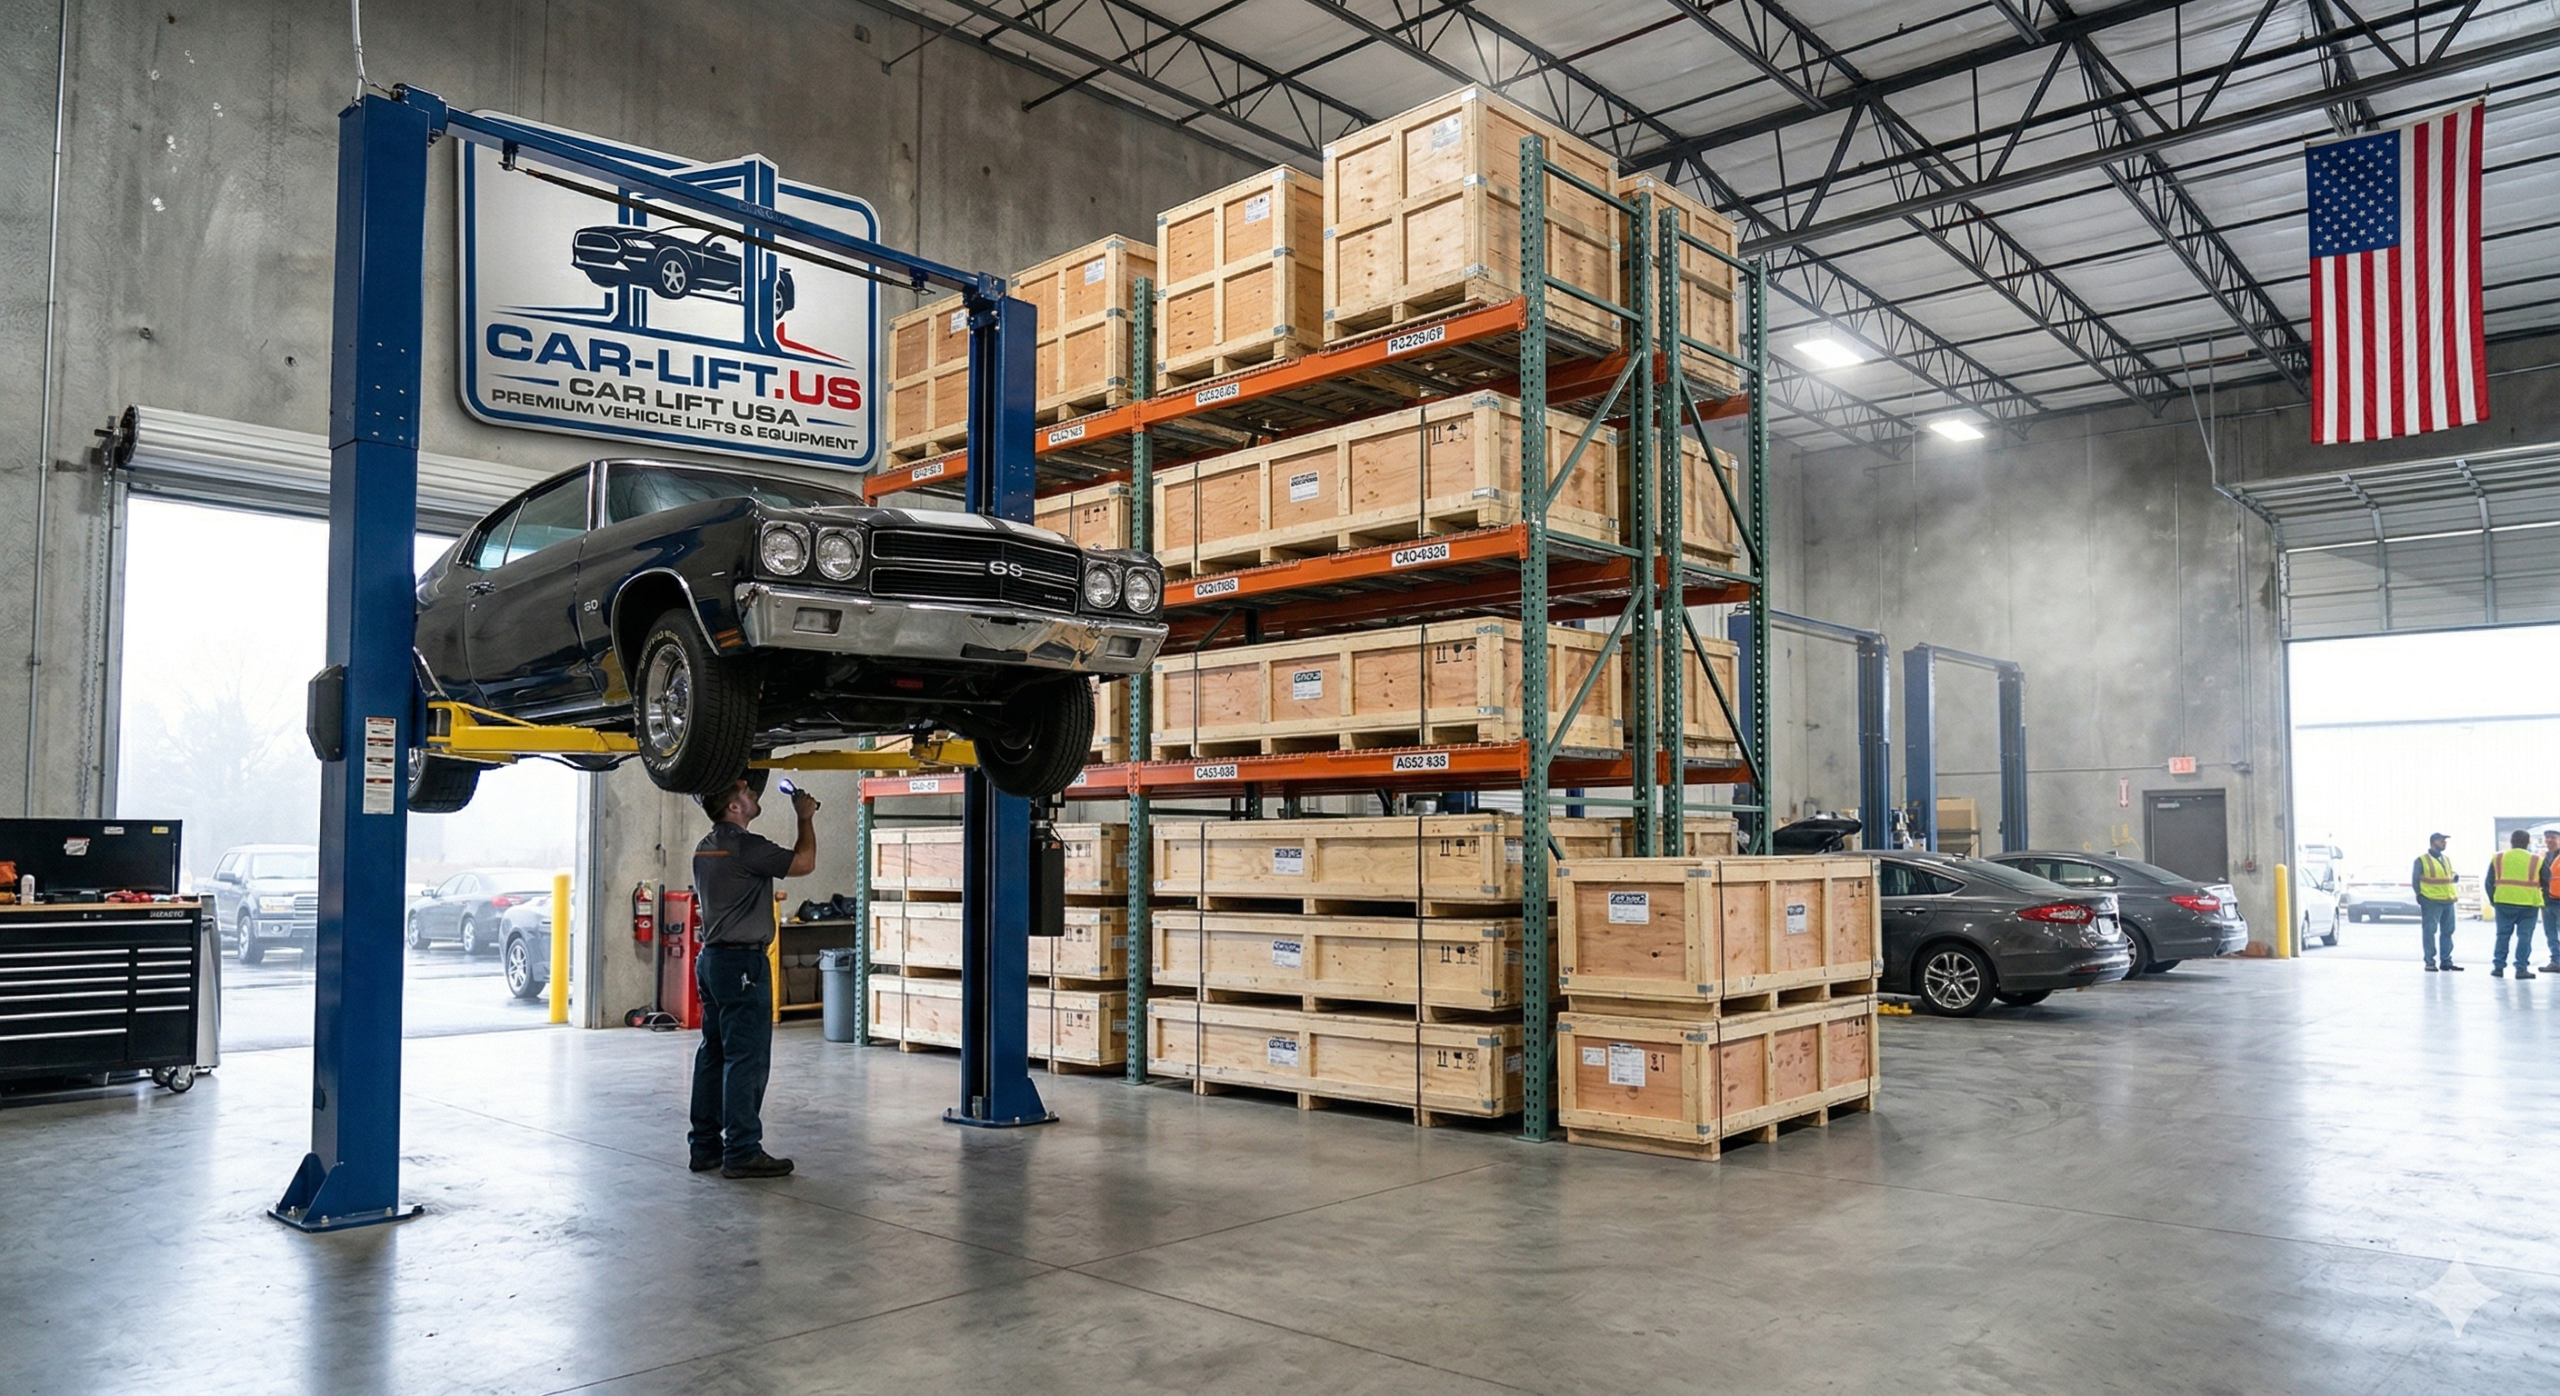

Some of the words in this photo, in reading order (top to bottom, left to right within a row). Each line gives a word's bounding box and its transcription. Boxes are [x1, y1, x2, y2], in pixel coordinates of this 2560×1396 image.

[486, 323, 862, 410] CAR-LIFT.US
[492, 388, 594, 415] PREMIUM
[599, 403, 683, 427] VEHICLE
[686, 416, 737, 434] LIFTS
[740, 424, 754, 437] &
[757, 426, 859, 451] EQUIPMENT
[569, 377, 646, 405] CAR
[656, 389, 724, 416] LIFT
[732, 400, 800, 427] USA
